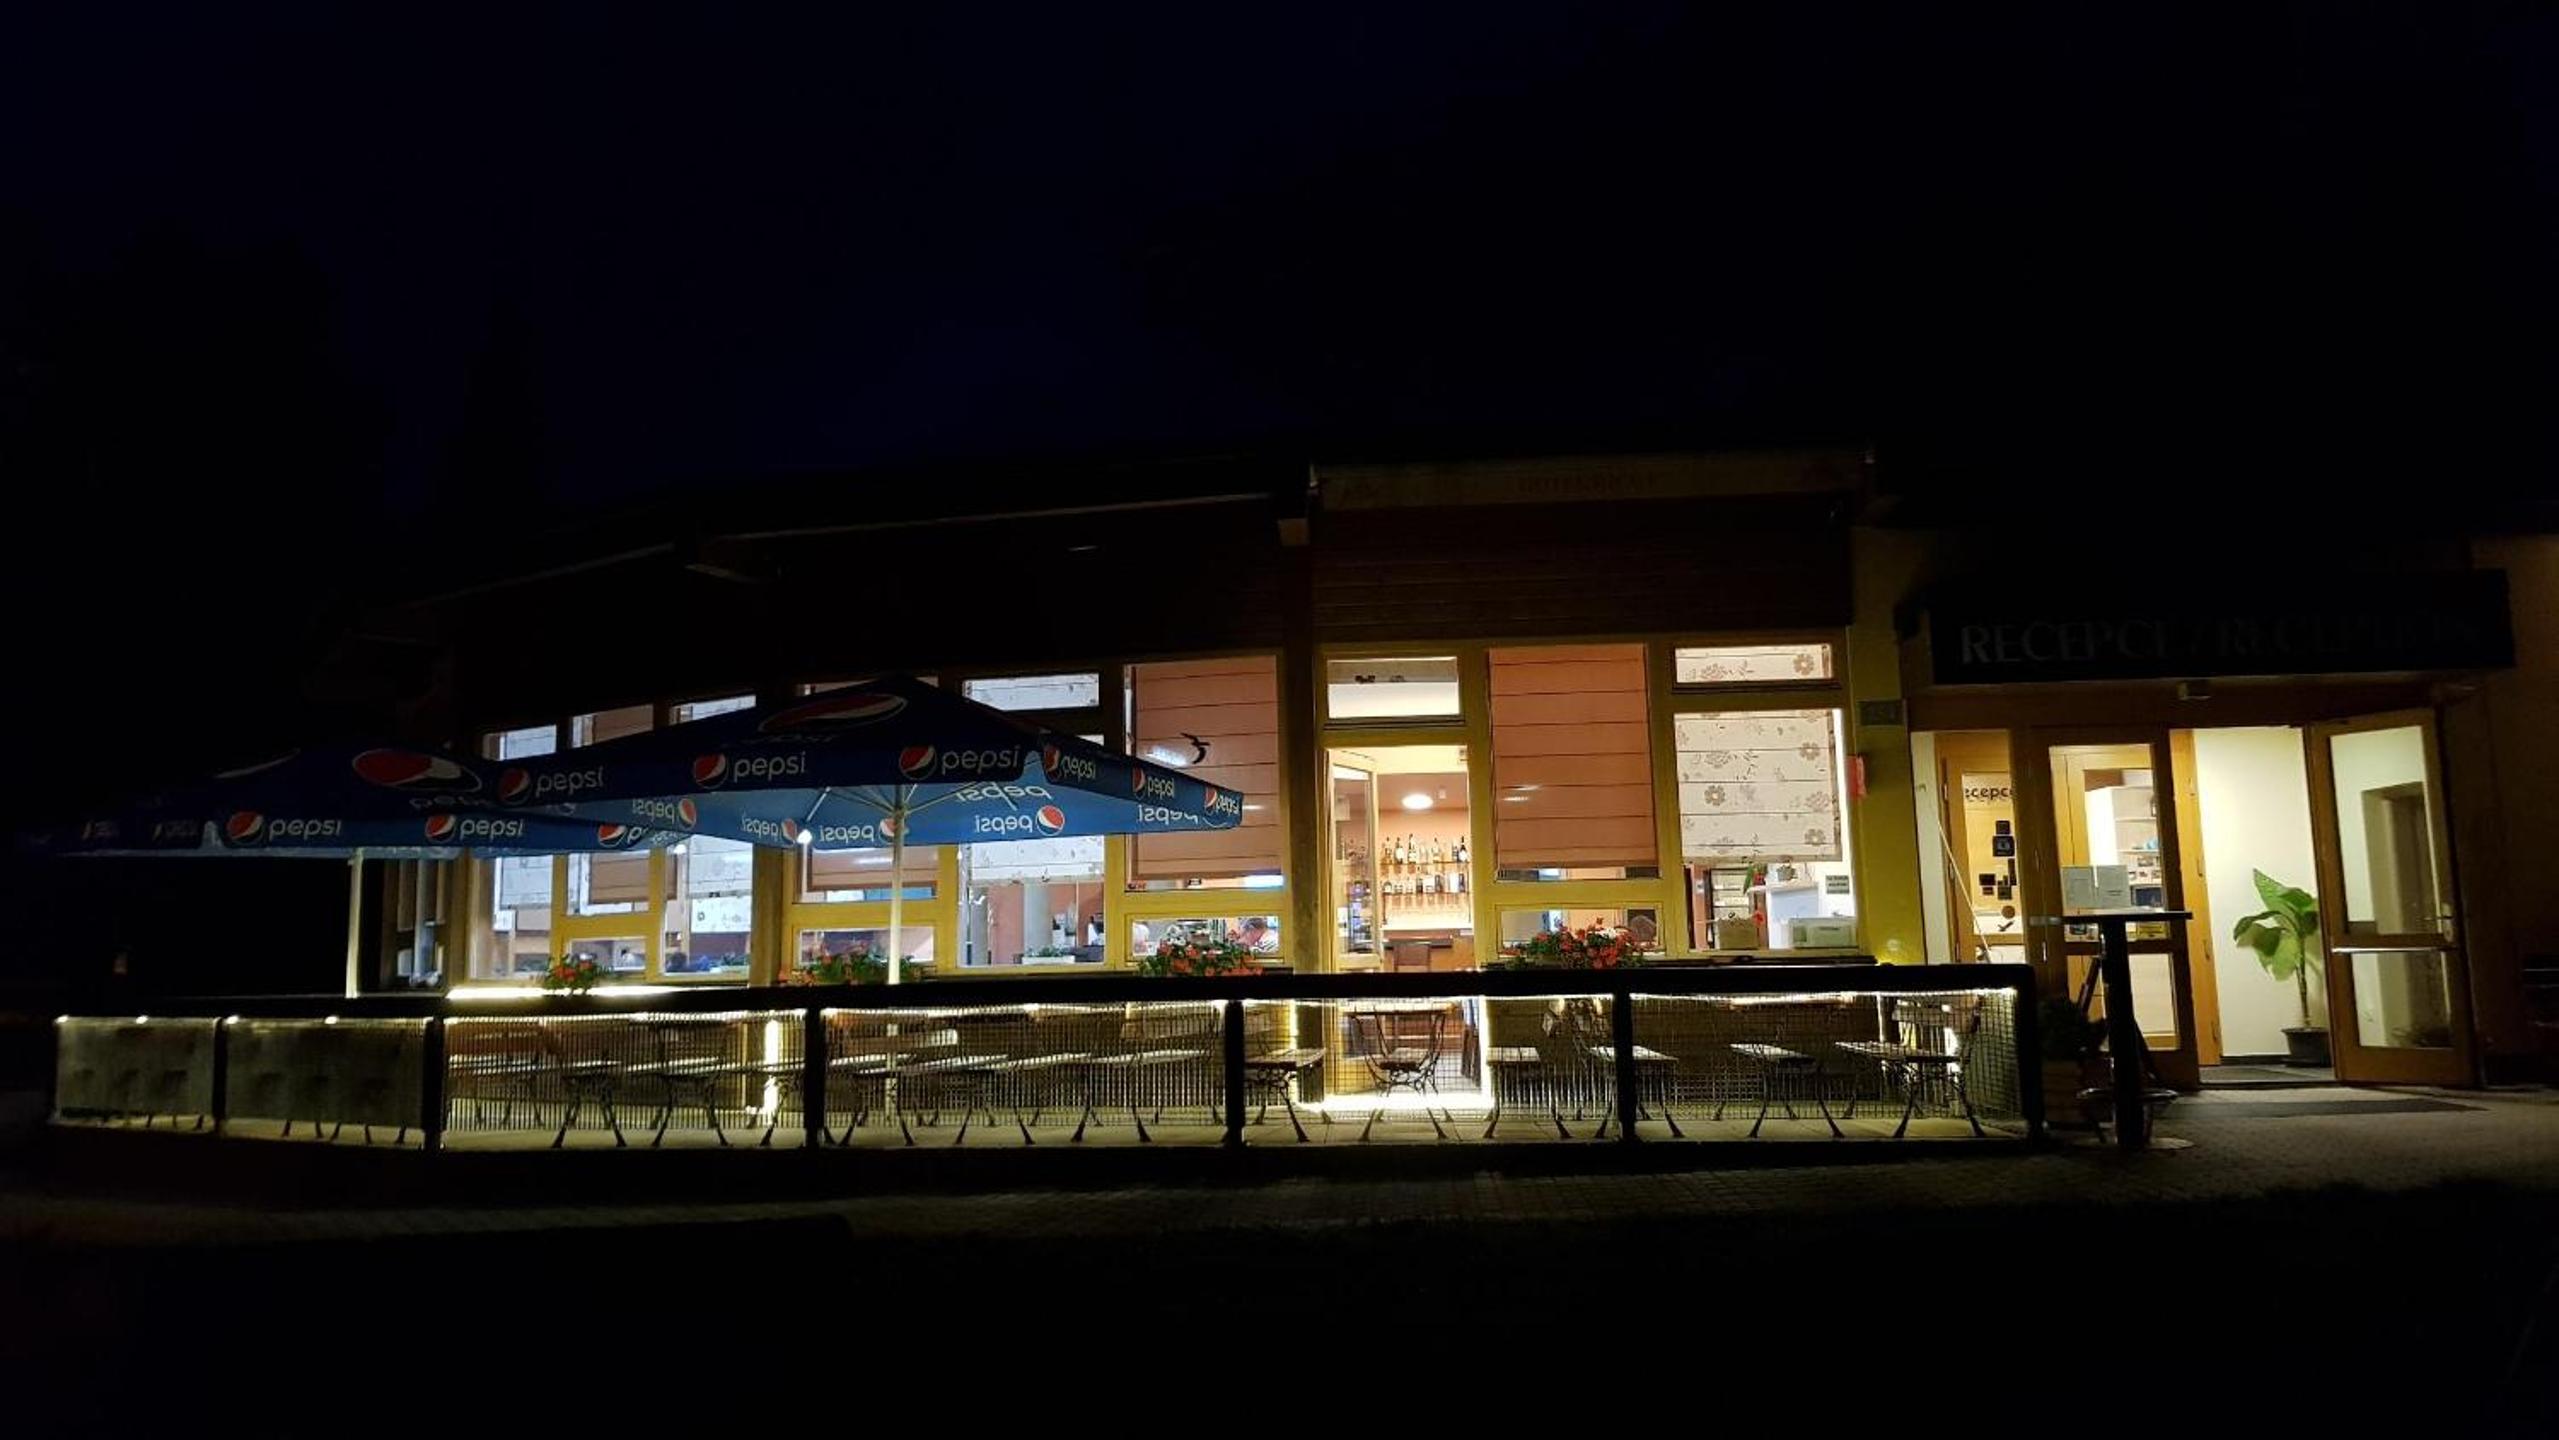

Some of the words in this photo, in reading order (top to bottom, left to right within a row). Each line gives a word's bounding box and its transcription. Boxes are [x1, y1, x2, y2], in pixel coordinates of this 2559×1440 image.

[733, 750, 806, 783] pepsi
[940, 745, 1022, 774] pepsi
[1061, 755, 1097, 781] pepsi
[535, 765, 604, 798] pepsi
[1147, 775, 1175, 799] pepsi
[1216, 795, 1240, 816] pepsi
[269, 817, 342, 842] pepsi
[459, 818, 525, 840] pepsi
